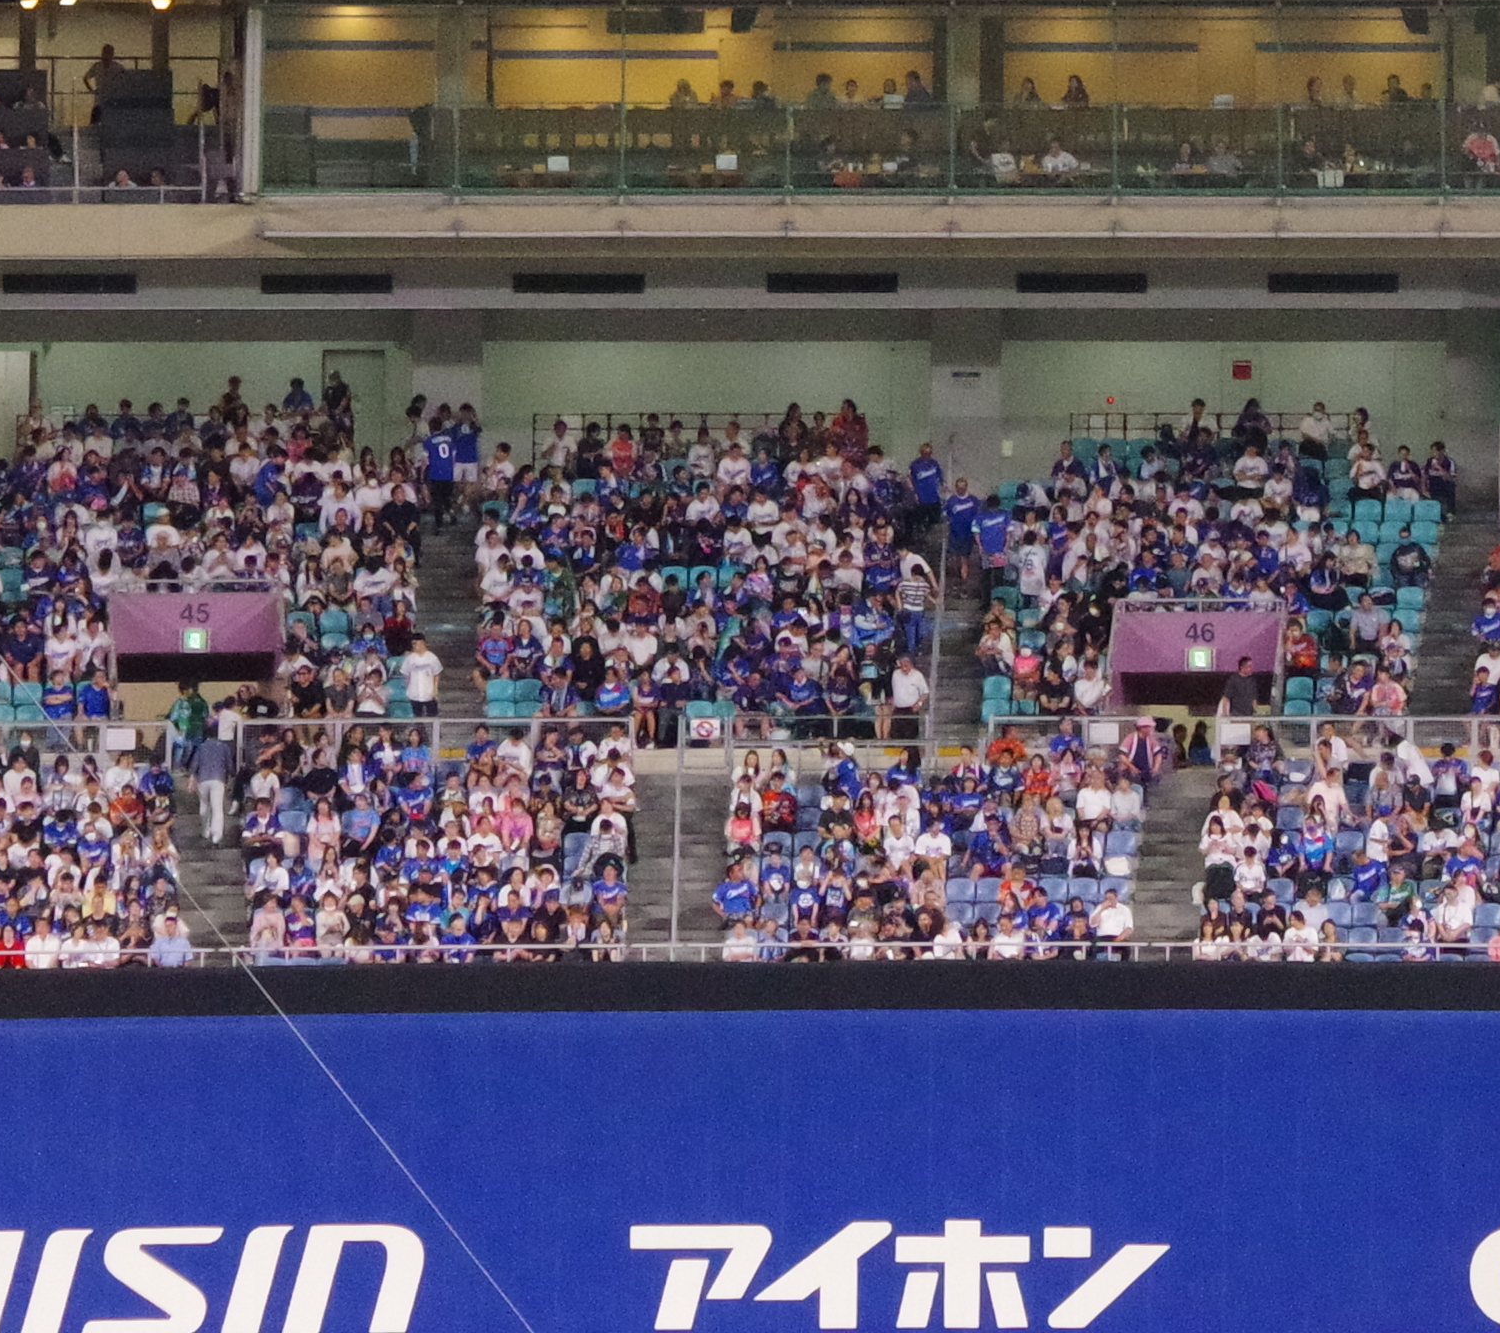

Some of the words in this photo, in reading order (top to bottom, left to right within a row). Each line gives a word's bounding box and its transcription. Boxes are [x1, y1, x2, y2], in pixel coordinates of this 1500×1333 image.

[180, 603, 211, 624] 45
[1185, 623, 1216, 644] 46
[630, 1220, 1171, 1330] アイホン
